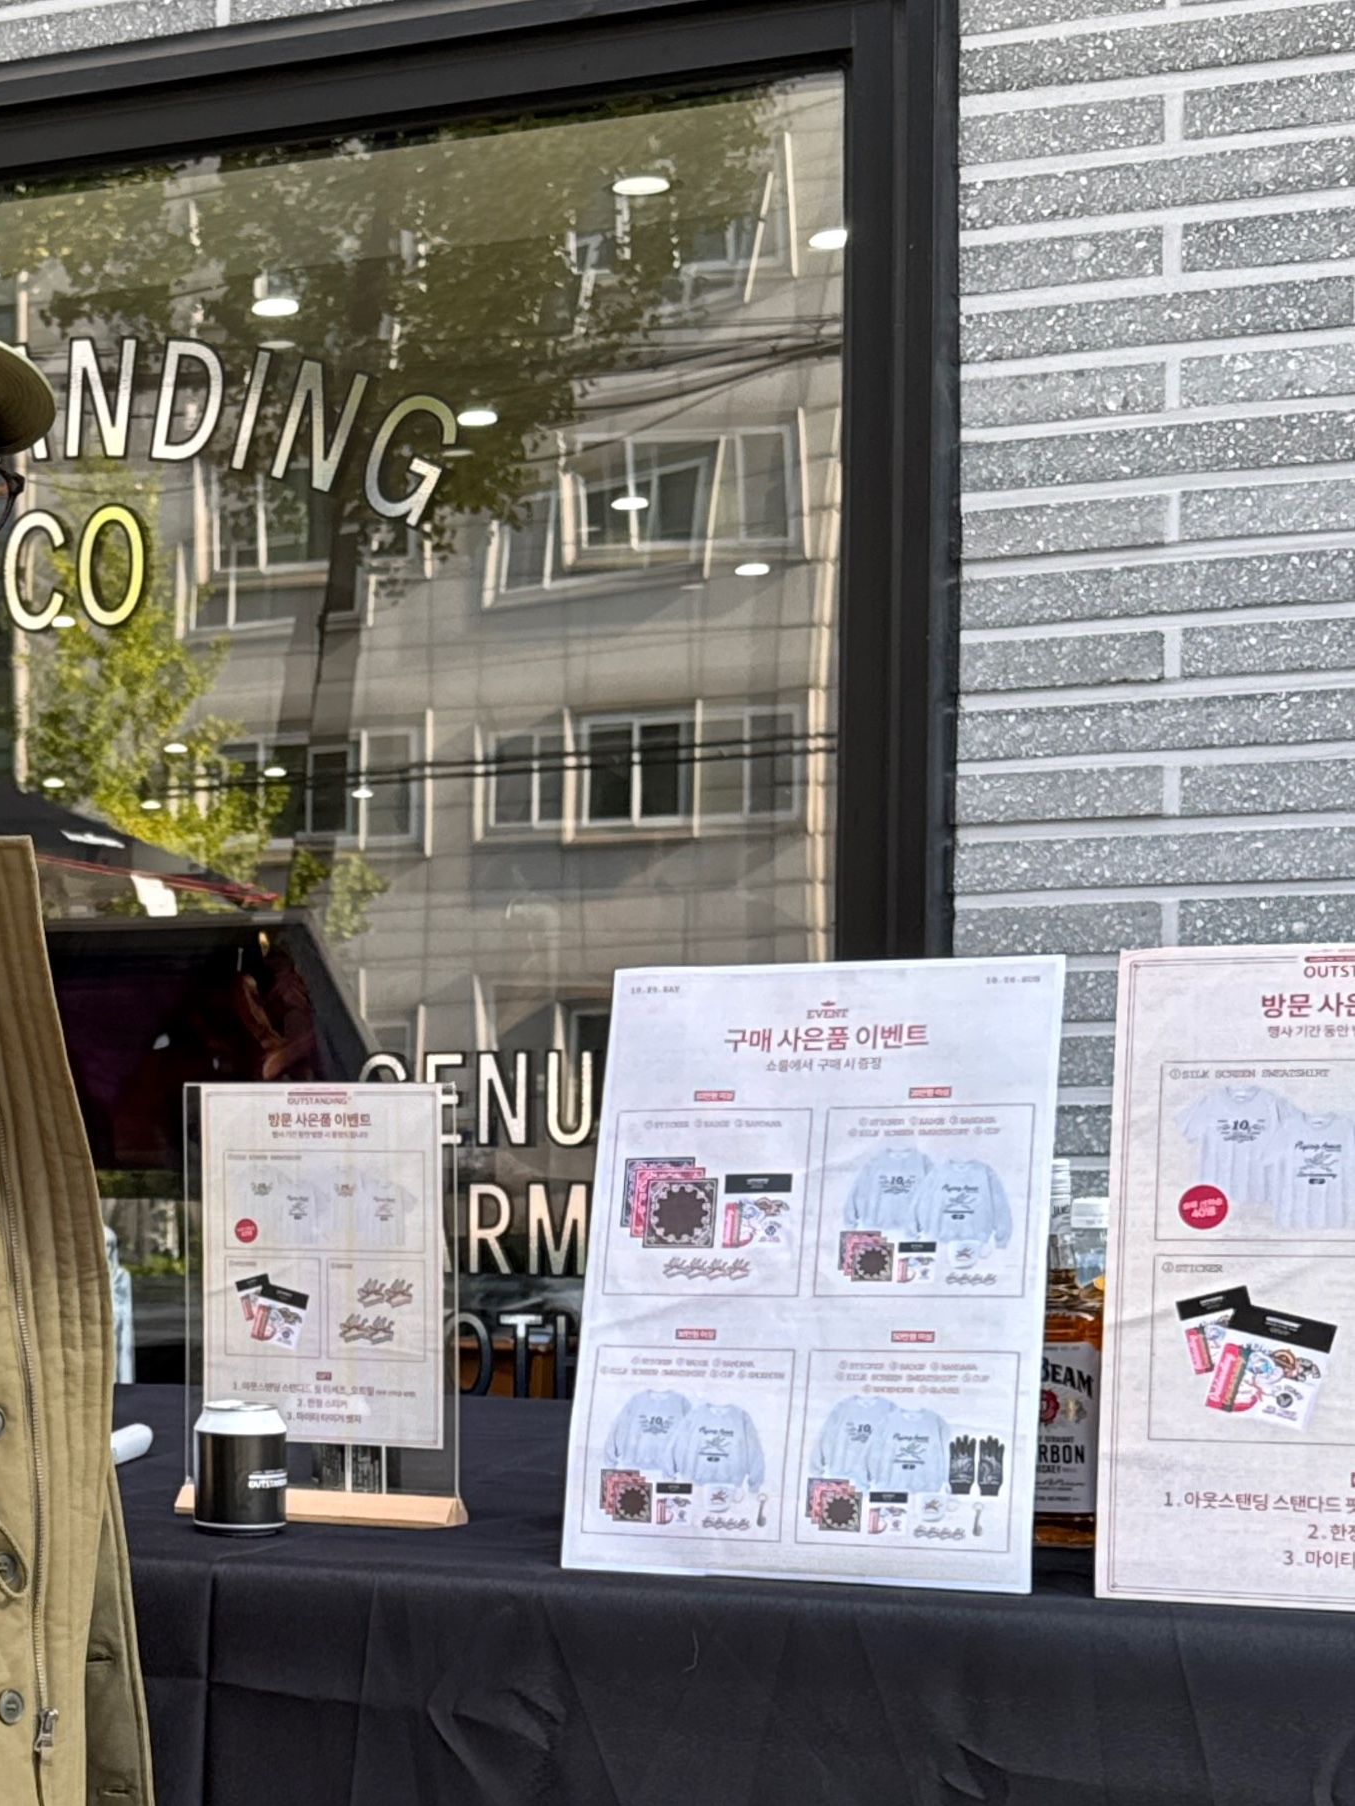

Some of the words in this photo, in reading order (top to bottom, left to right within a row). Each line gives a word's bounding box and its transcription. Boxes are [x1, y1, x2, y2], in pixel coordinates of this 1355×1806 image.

[1, 501, 147, 633] CO
[807, 1009, 849, 1019] EVENT
[1261, 993, 1312, 1018] 방문
[724, 1027, 773, 1053] 구매
[777, 1026, 850, 1053] 사은품
[856, 1023, 929, 1050] 이벤트
[1296, 1025, 1321, 1038] 기간
[1324, 1024, 1349, 1037] 동안
[817, 1058, 842, 1072] 구매
[268, 1112, 292, 1128] 방문
[295, 1112, 332, 1128] 사은품
[334, 1112, 372, 1128] 이벤트
[445, 1180, 589, 1277] RM
[1272, 1495, 1342, 1514] 스탠다드
